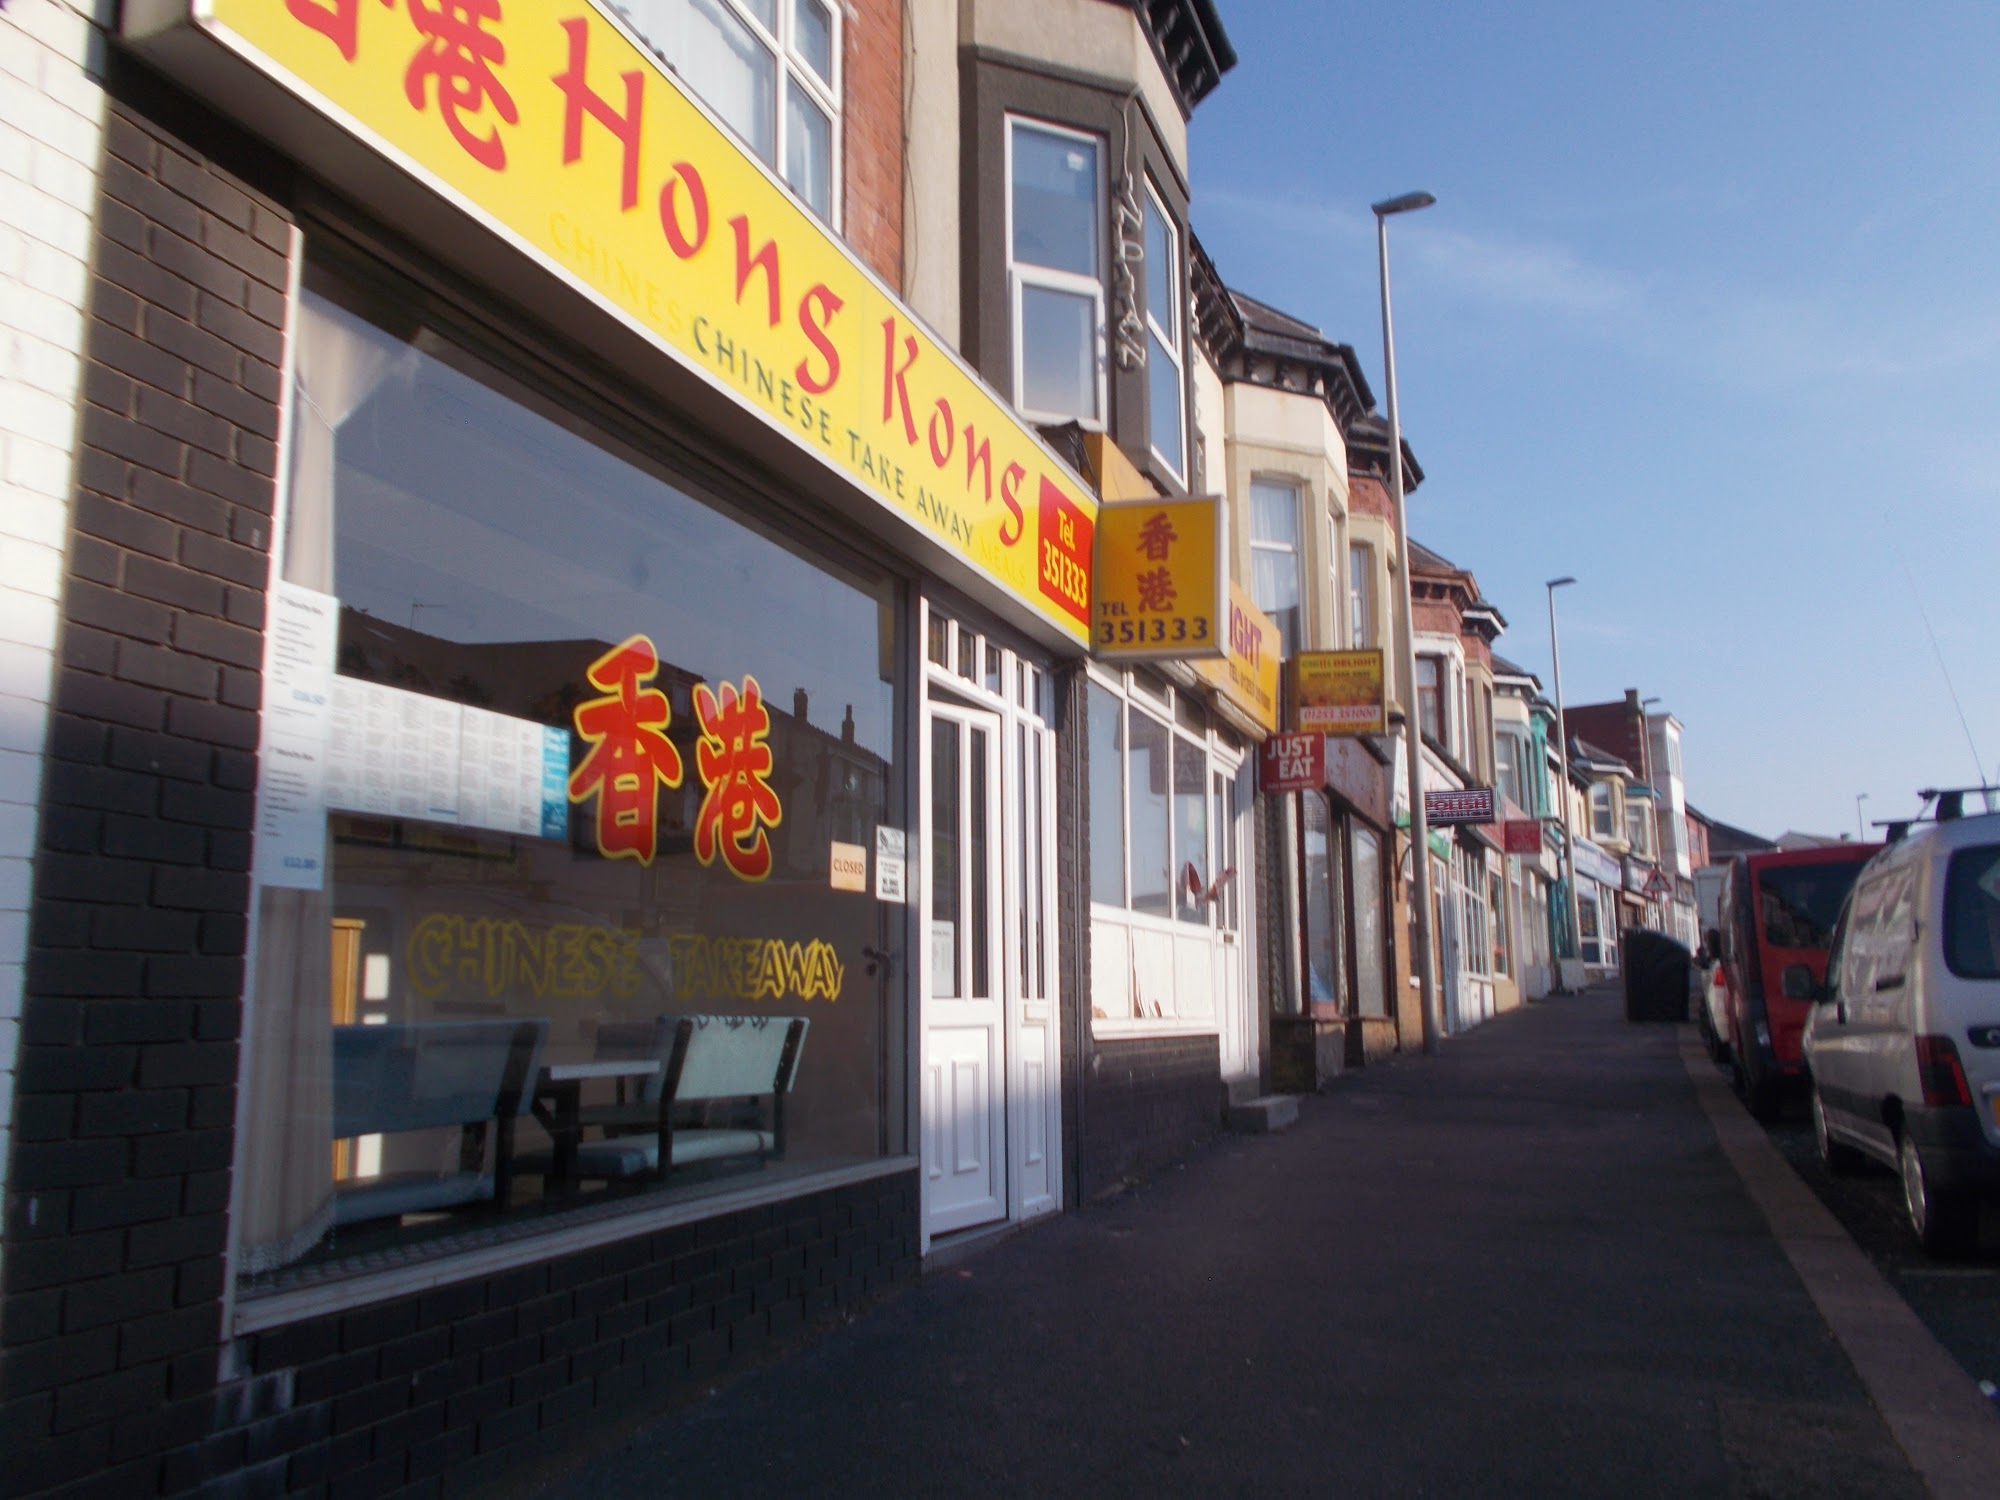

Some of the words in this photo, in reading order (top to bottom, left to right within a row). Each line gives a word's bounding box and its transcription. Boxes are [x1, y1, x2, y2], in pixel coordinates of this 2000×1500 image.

[692, 316, 832, 447] CHINESE
[847, 428, 907, 501] TAKE
[916, 487, 974, 548] AWAY
[1043, 536, 1087, 609] 351333
[1136, 511, 1178, 614] 香港
[1101, 601, 1128, 616] TEL
[1101, 616, 1208, 643] 351333
[568, 634, 781, 881] 香港
[1267, 735, 1315, 760] JUST
[1279, 756, 1315, 780] EAT
[833, 858, 865, 875] CLOSED
[406, 913, 643, 998] CHINESE
[669, 934, 844, 1002] TAKEAWAY
